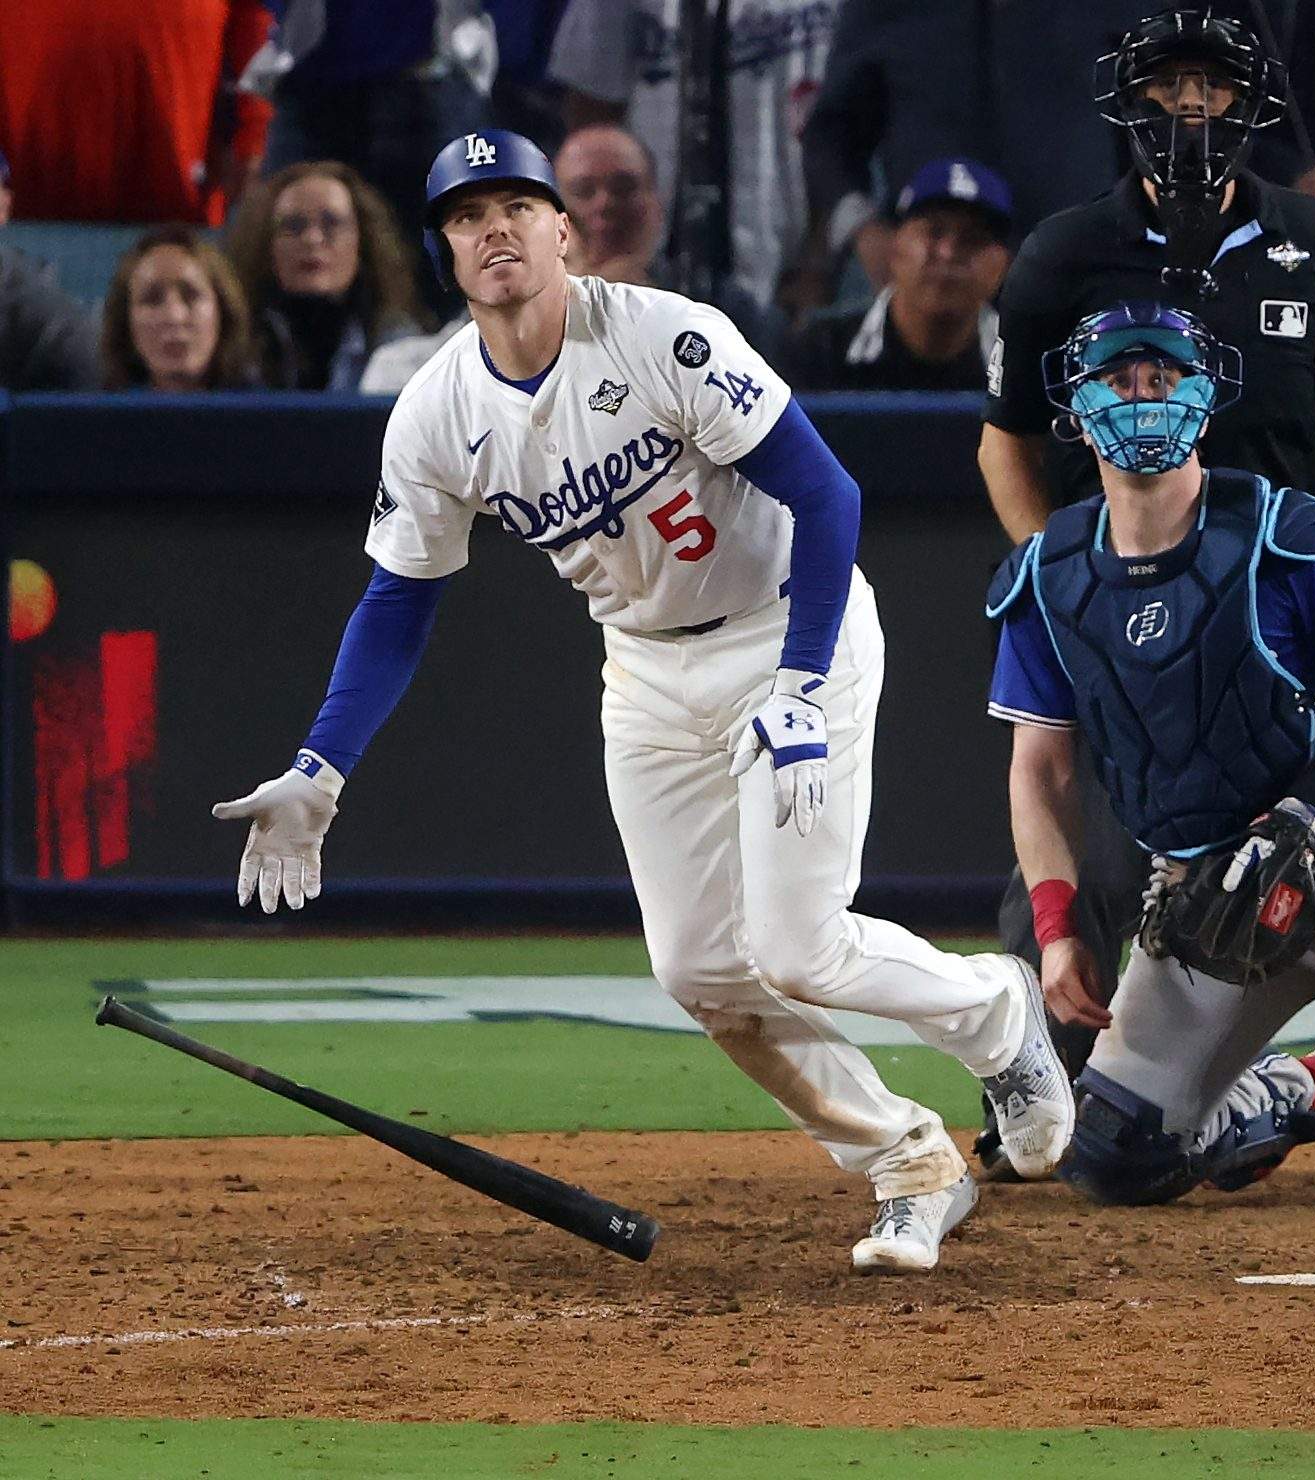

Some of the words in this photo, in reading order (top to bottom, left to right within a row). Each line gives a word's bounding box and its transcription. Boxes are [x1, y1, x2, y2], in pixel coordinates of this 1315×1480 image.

[465, 133, 496, 167] LA
[685, 338, 708, 363] 34
[704, 371, 764, 416] LA
[484, 427, 685, 550] Dodgers
[647, 488, 717, 562] 5
[296, 755, 313, 770] 5
